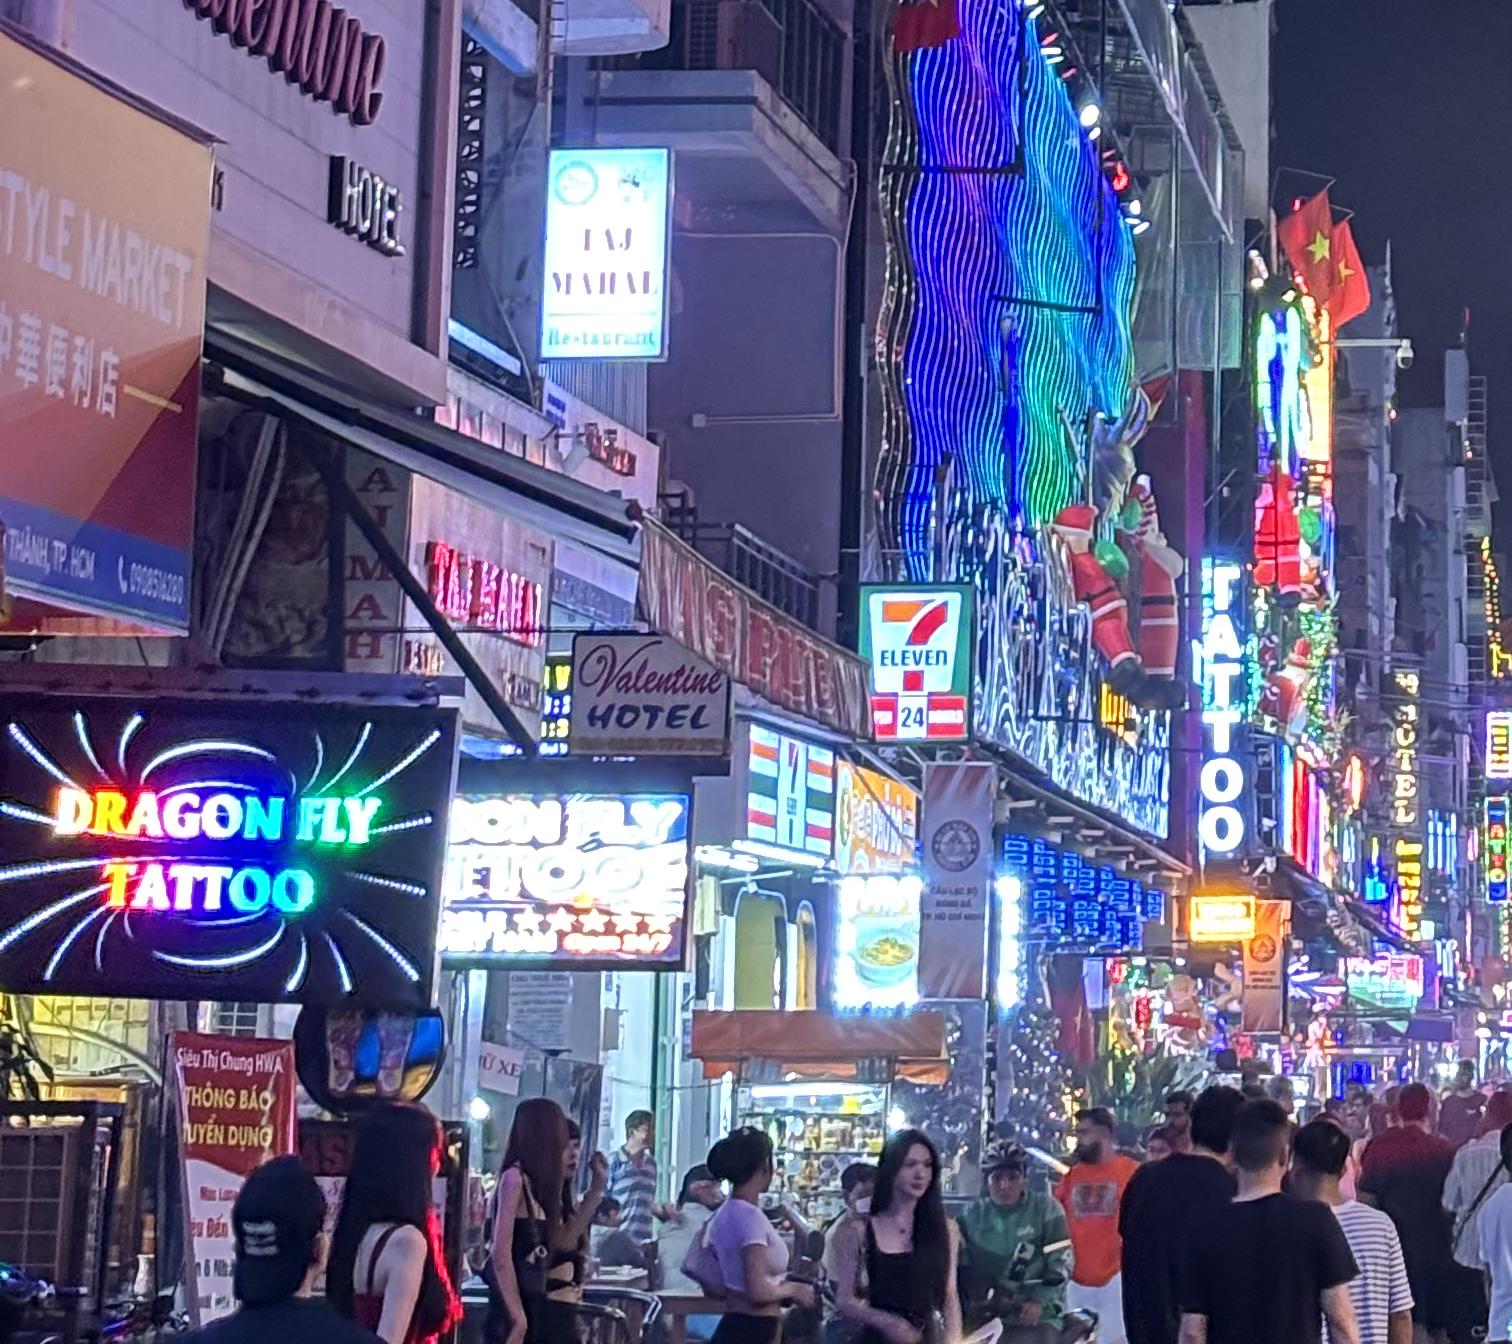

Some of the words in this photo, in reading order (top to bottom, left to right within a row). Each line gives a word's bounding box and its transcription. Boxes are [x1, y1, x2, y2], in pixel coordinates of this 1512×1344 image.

[80, 208, 191, 330] MARKET
[579, 639, 724, 699] Valentine
[587, 703, 711, 731] HOTEL
[901, 707, 925, 729] 24
[1198, 564, 1244, 852] TATTOO
[53, 787, 285, 842] DRAGON
[296, 797, 383, 845] FLY
[101, 862, 315, 912] TATTOO
[177, 1046, 201, 1069] Siêu
[202, 1048, 219, 1072] Thị
[219, 1050, 255, 1077] Chung
[255, 1052, 285, 1074] HWA
[497, 1059, 521, 1077] XE
[185, 1081, 236, 1109] THÔNG
[239, 1084, 273, 1112] BÁO
